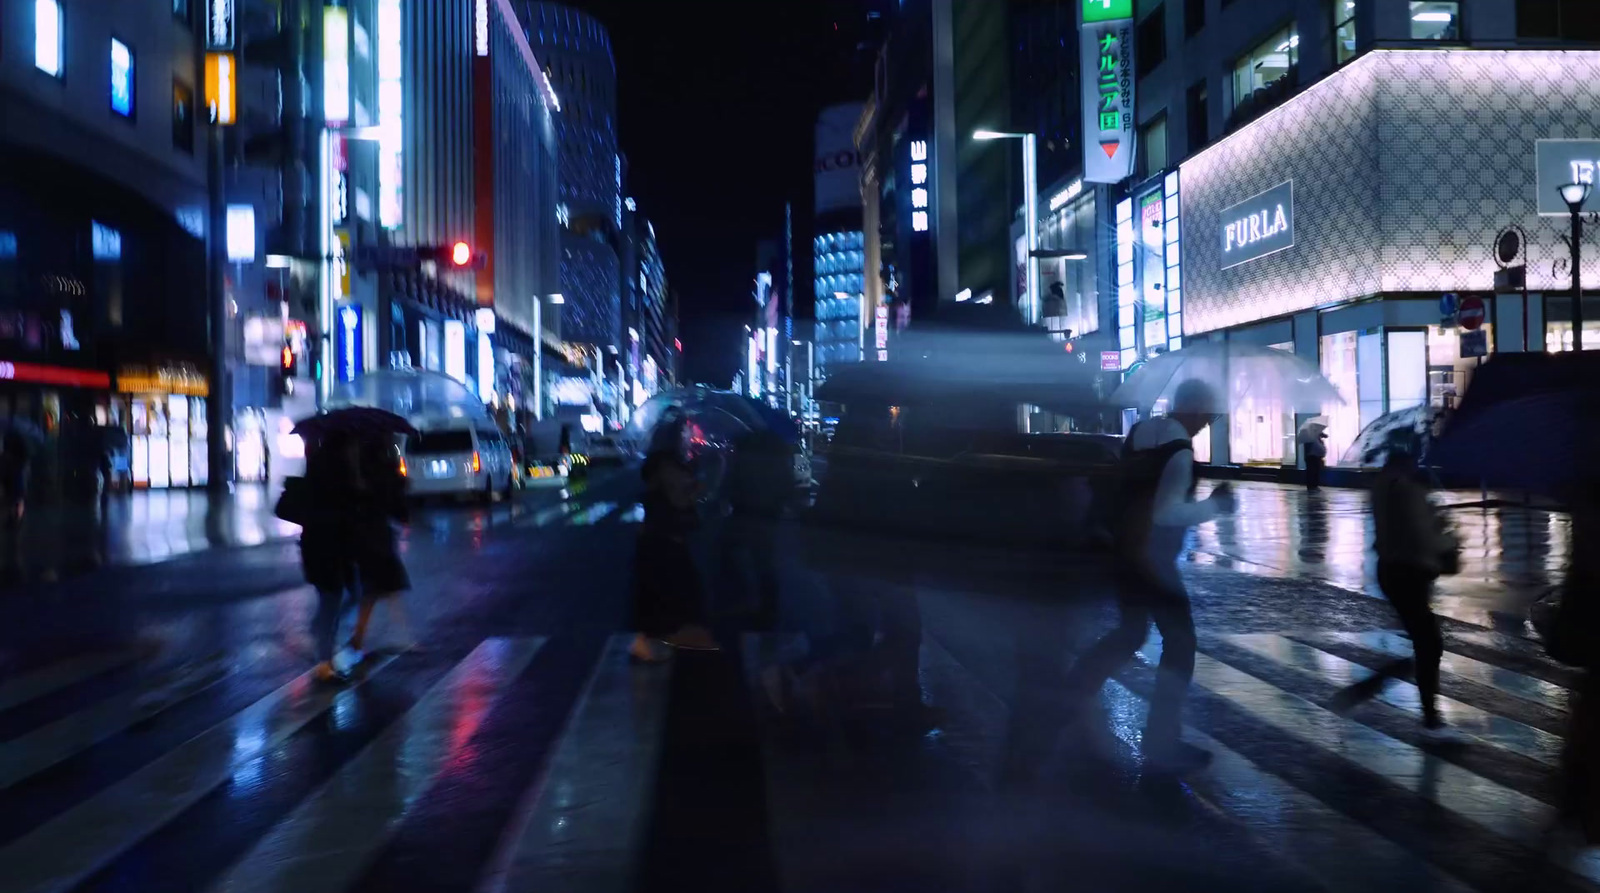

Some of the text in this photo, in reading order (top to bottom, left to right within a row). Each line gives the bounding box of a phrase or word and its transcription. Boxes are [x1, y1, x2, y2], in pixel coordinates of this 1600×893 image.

[1099, 32, 1119, 131] ナルニア国
[1119, 27, 1131, 132] 子どもの本のみせ 6F
[1224, 203, 1288, 252] FURLA
